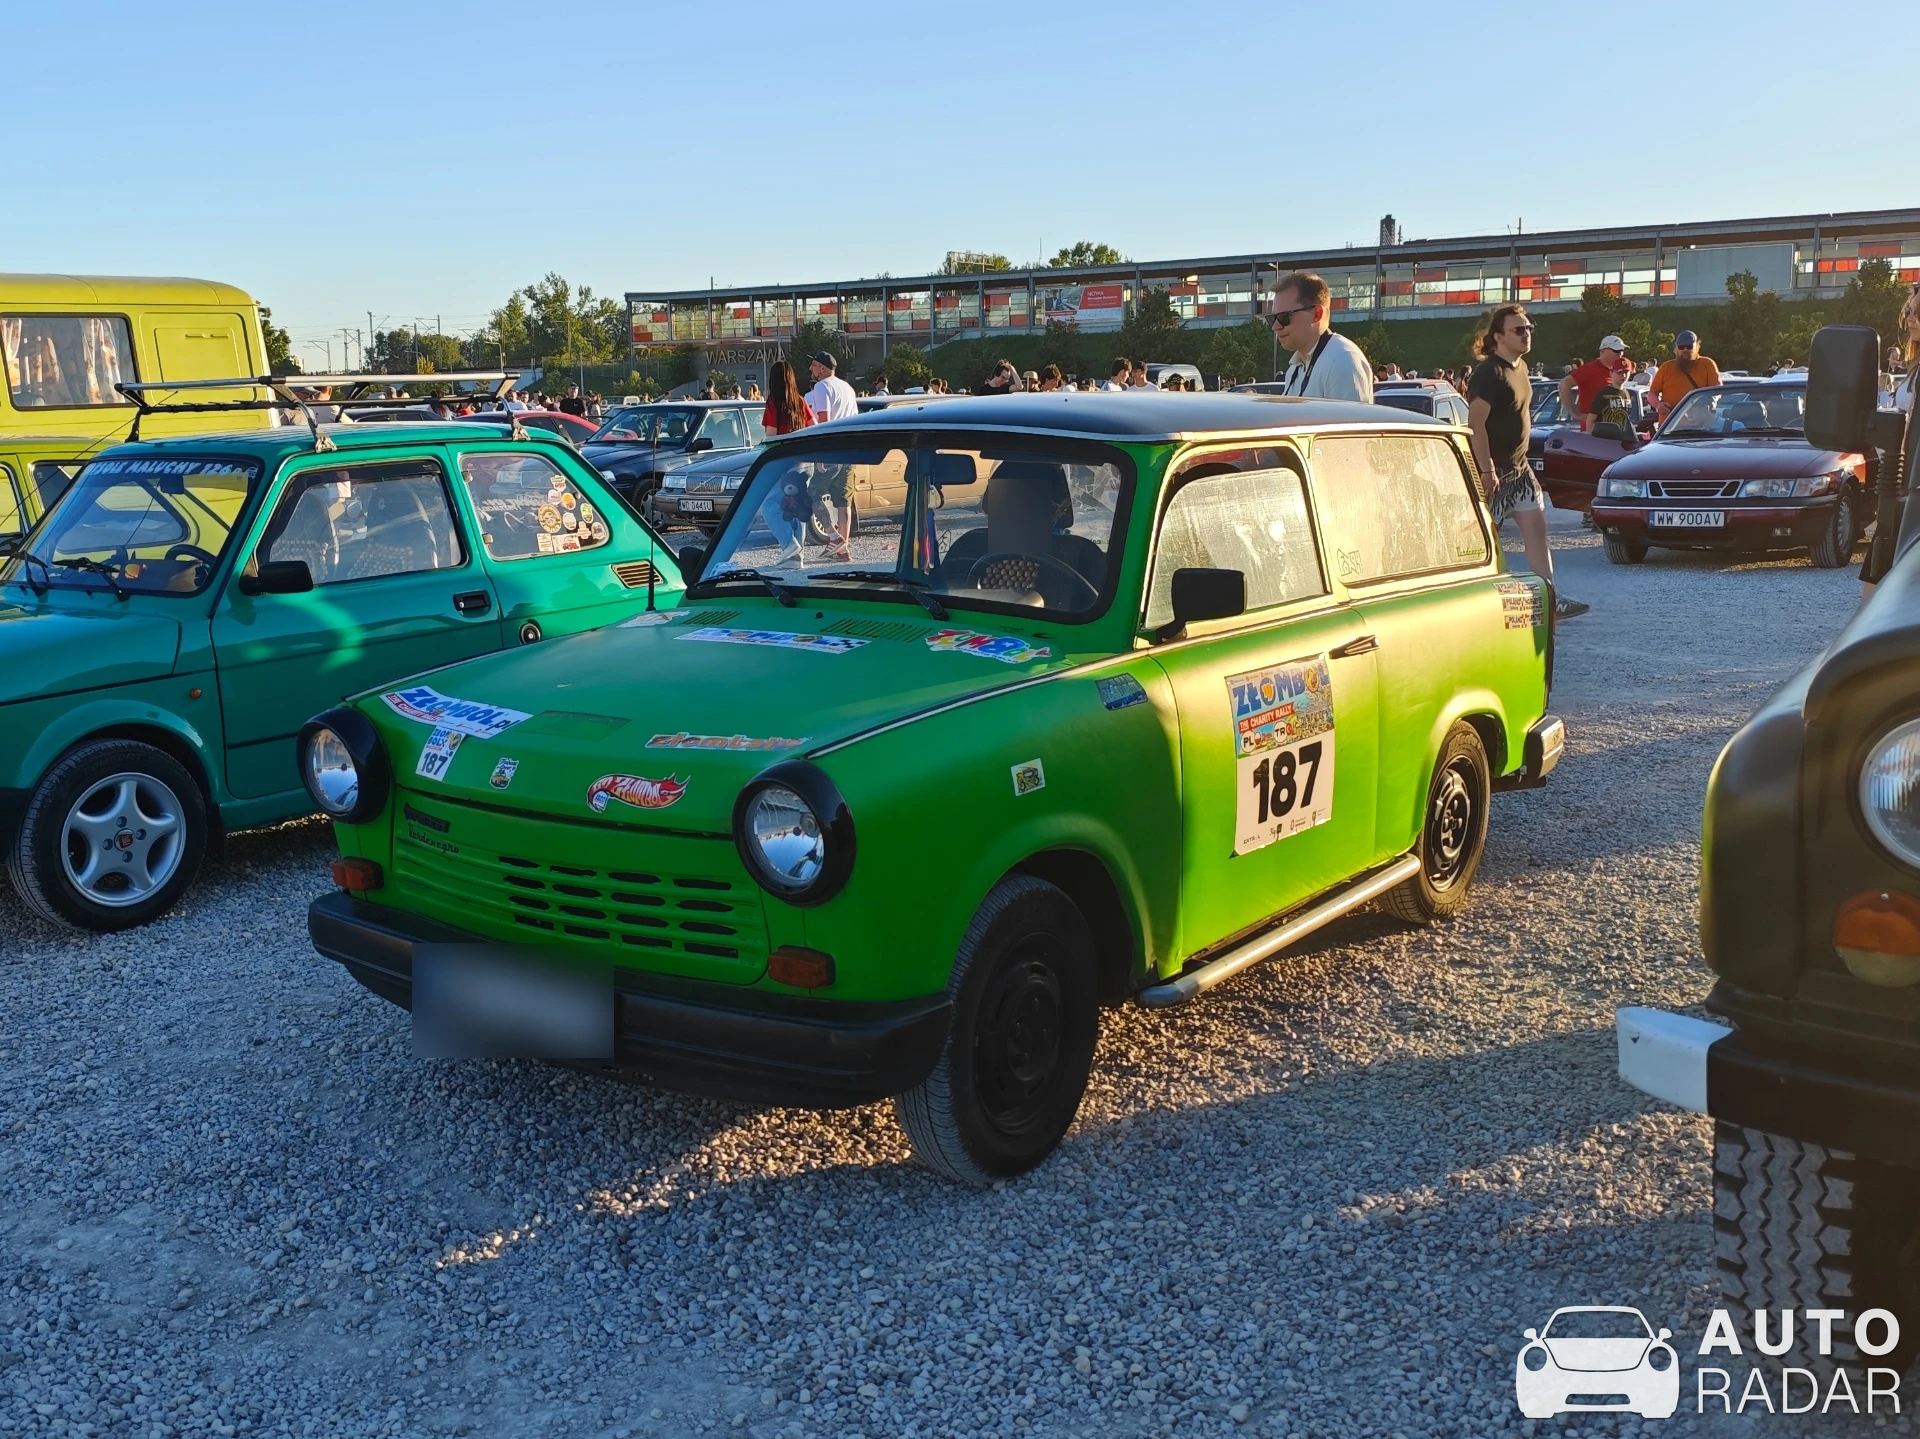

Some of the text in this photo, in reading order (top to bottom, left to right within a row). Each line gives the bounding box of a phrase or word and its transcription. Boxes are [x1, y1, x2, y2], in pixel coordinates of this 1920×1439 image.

[706, 350, 786, 364] WARSZAWA
[125, 461, 201, 475] MALUCHY
[1657, 513, 1721, 525] WW 900AV
[1232, 662, 1330, 717] ZŁOMBOL
[1240, 704, 1293, 730] THE CHARITY RALLY
[1274, 727, 1286, 737] TR
[1243, 736, 1254, 748] PL
[421, 751, 448, 776] 187
[1253, 740, 1322, 825] 187
